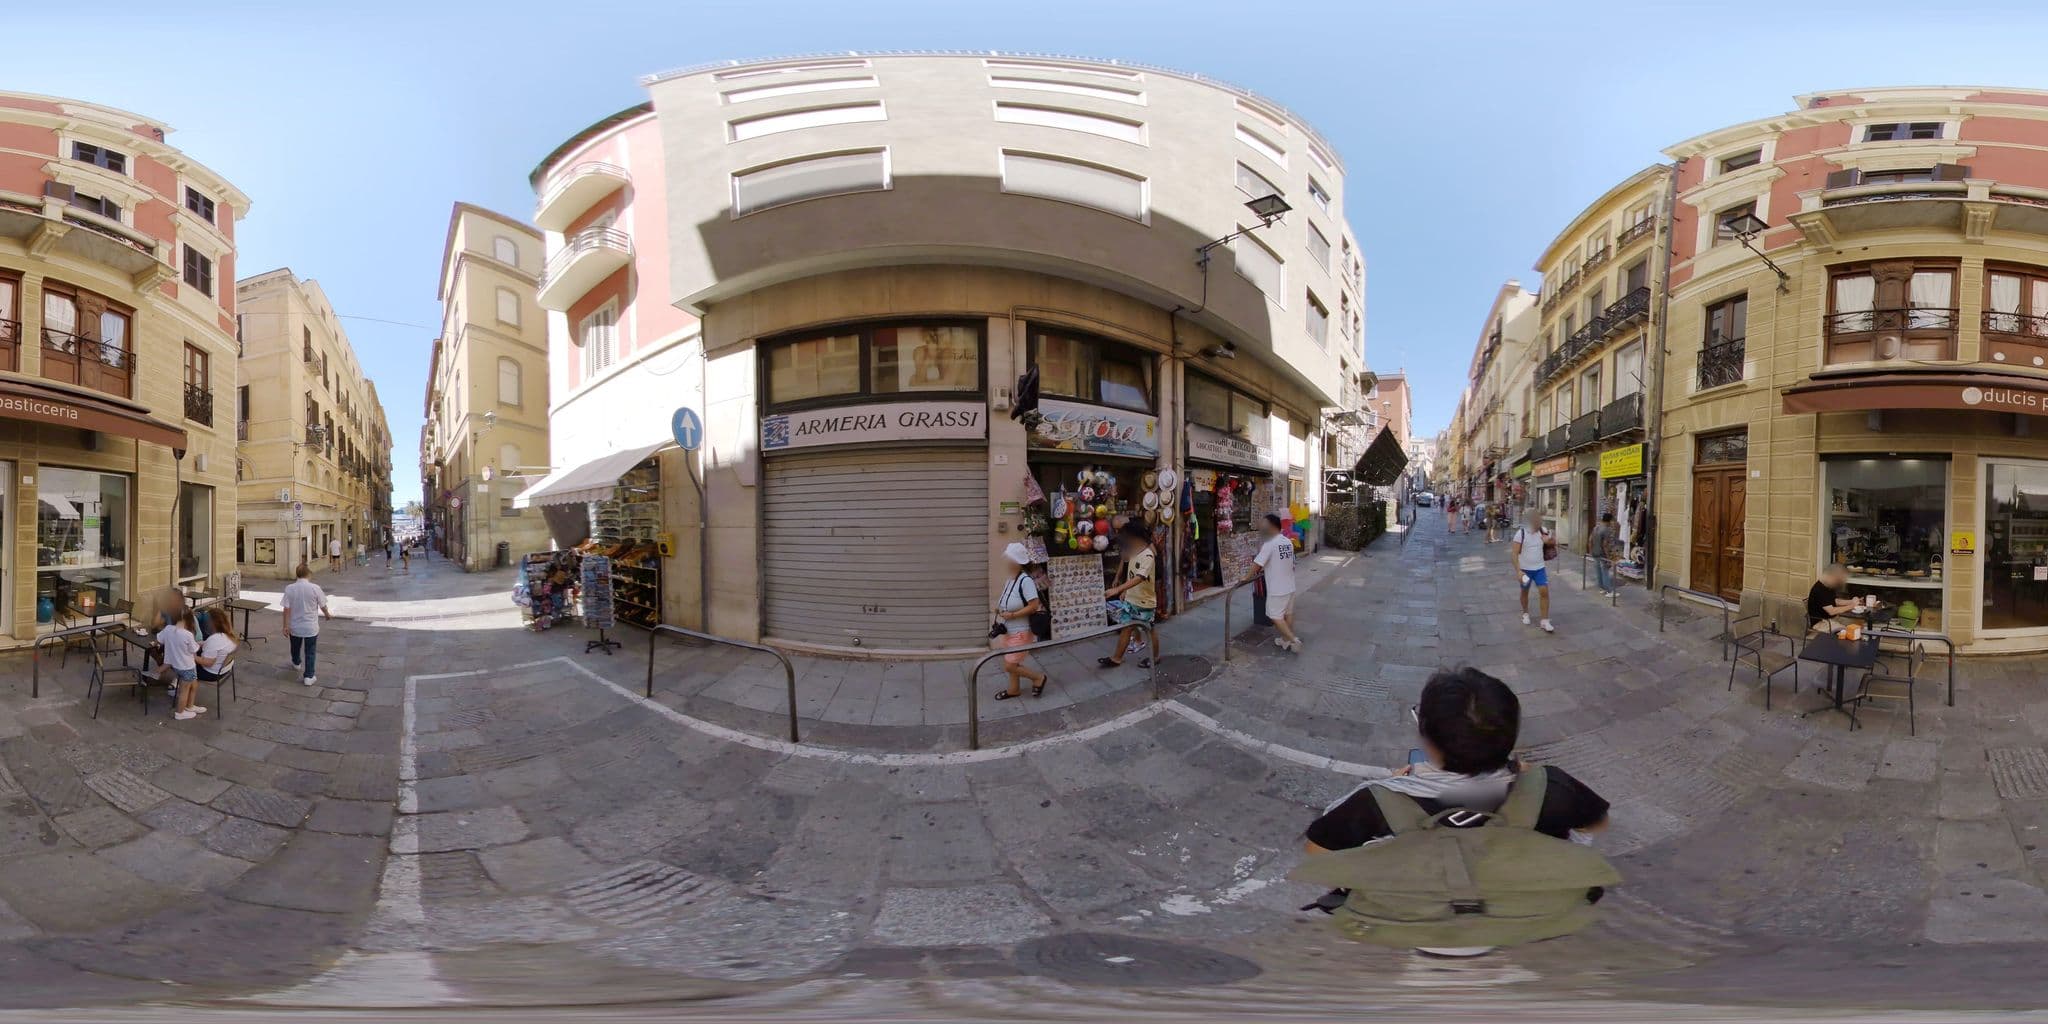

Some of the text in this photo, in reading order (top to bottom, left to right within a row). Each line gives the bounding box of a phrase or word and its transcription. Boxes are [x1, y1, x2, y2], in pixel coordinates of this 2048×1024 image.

[1984, 387, 2036, 406] dulcis
[795, 411, 978, 436] ARMERIA GRASSI
